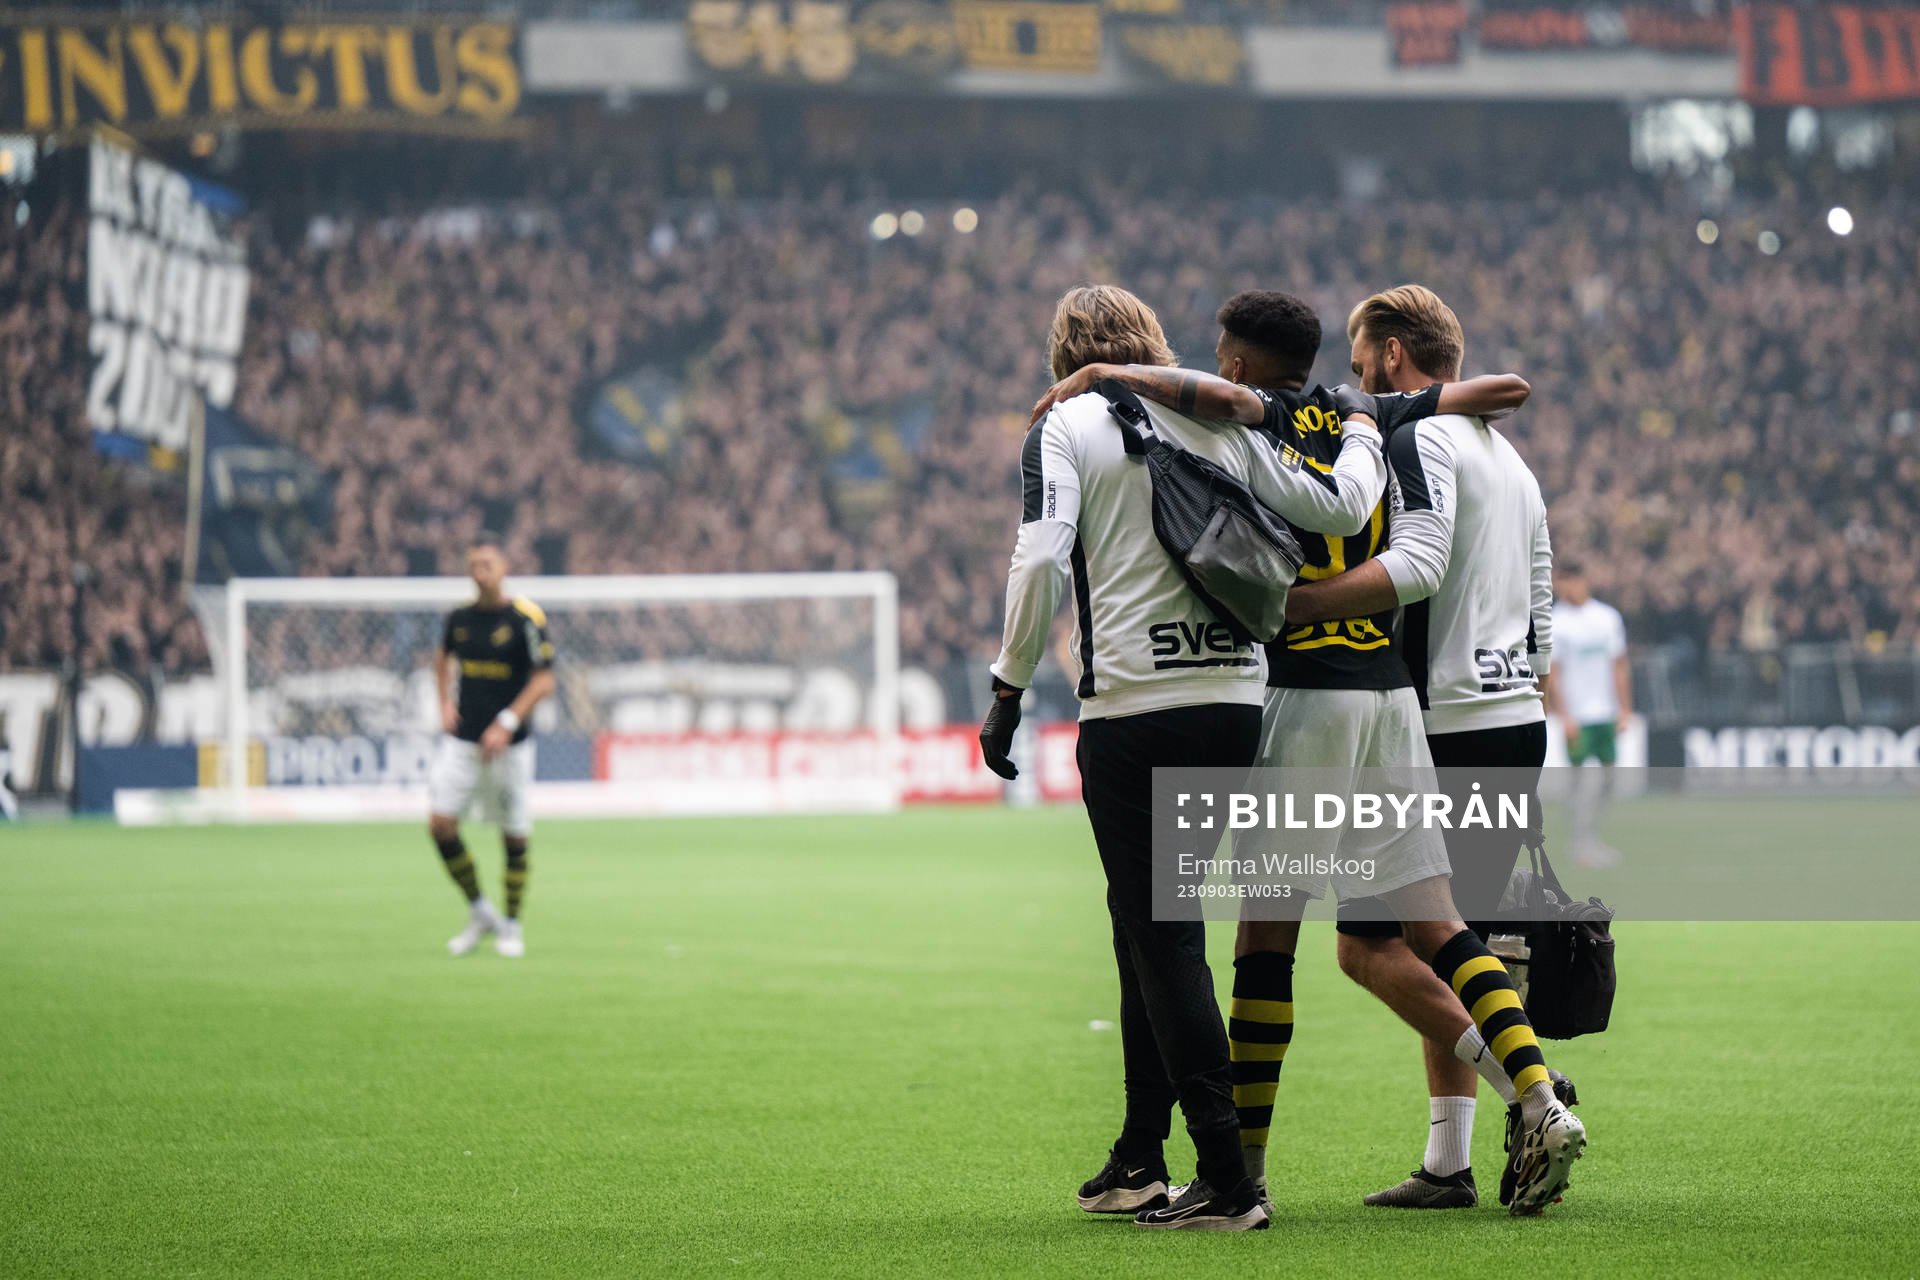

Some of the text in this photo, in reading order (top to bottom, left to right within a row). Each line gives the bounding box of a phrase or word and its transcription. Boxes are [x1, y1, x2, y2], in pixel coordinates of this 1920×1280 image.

[19, 23, 521, 129] INVICTUS
[1046, 480, 1056, 519] stadium
[1149, 621, 1255, 656] SVE
